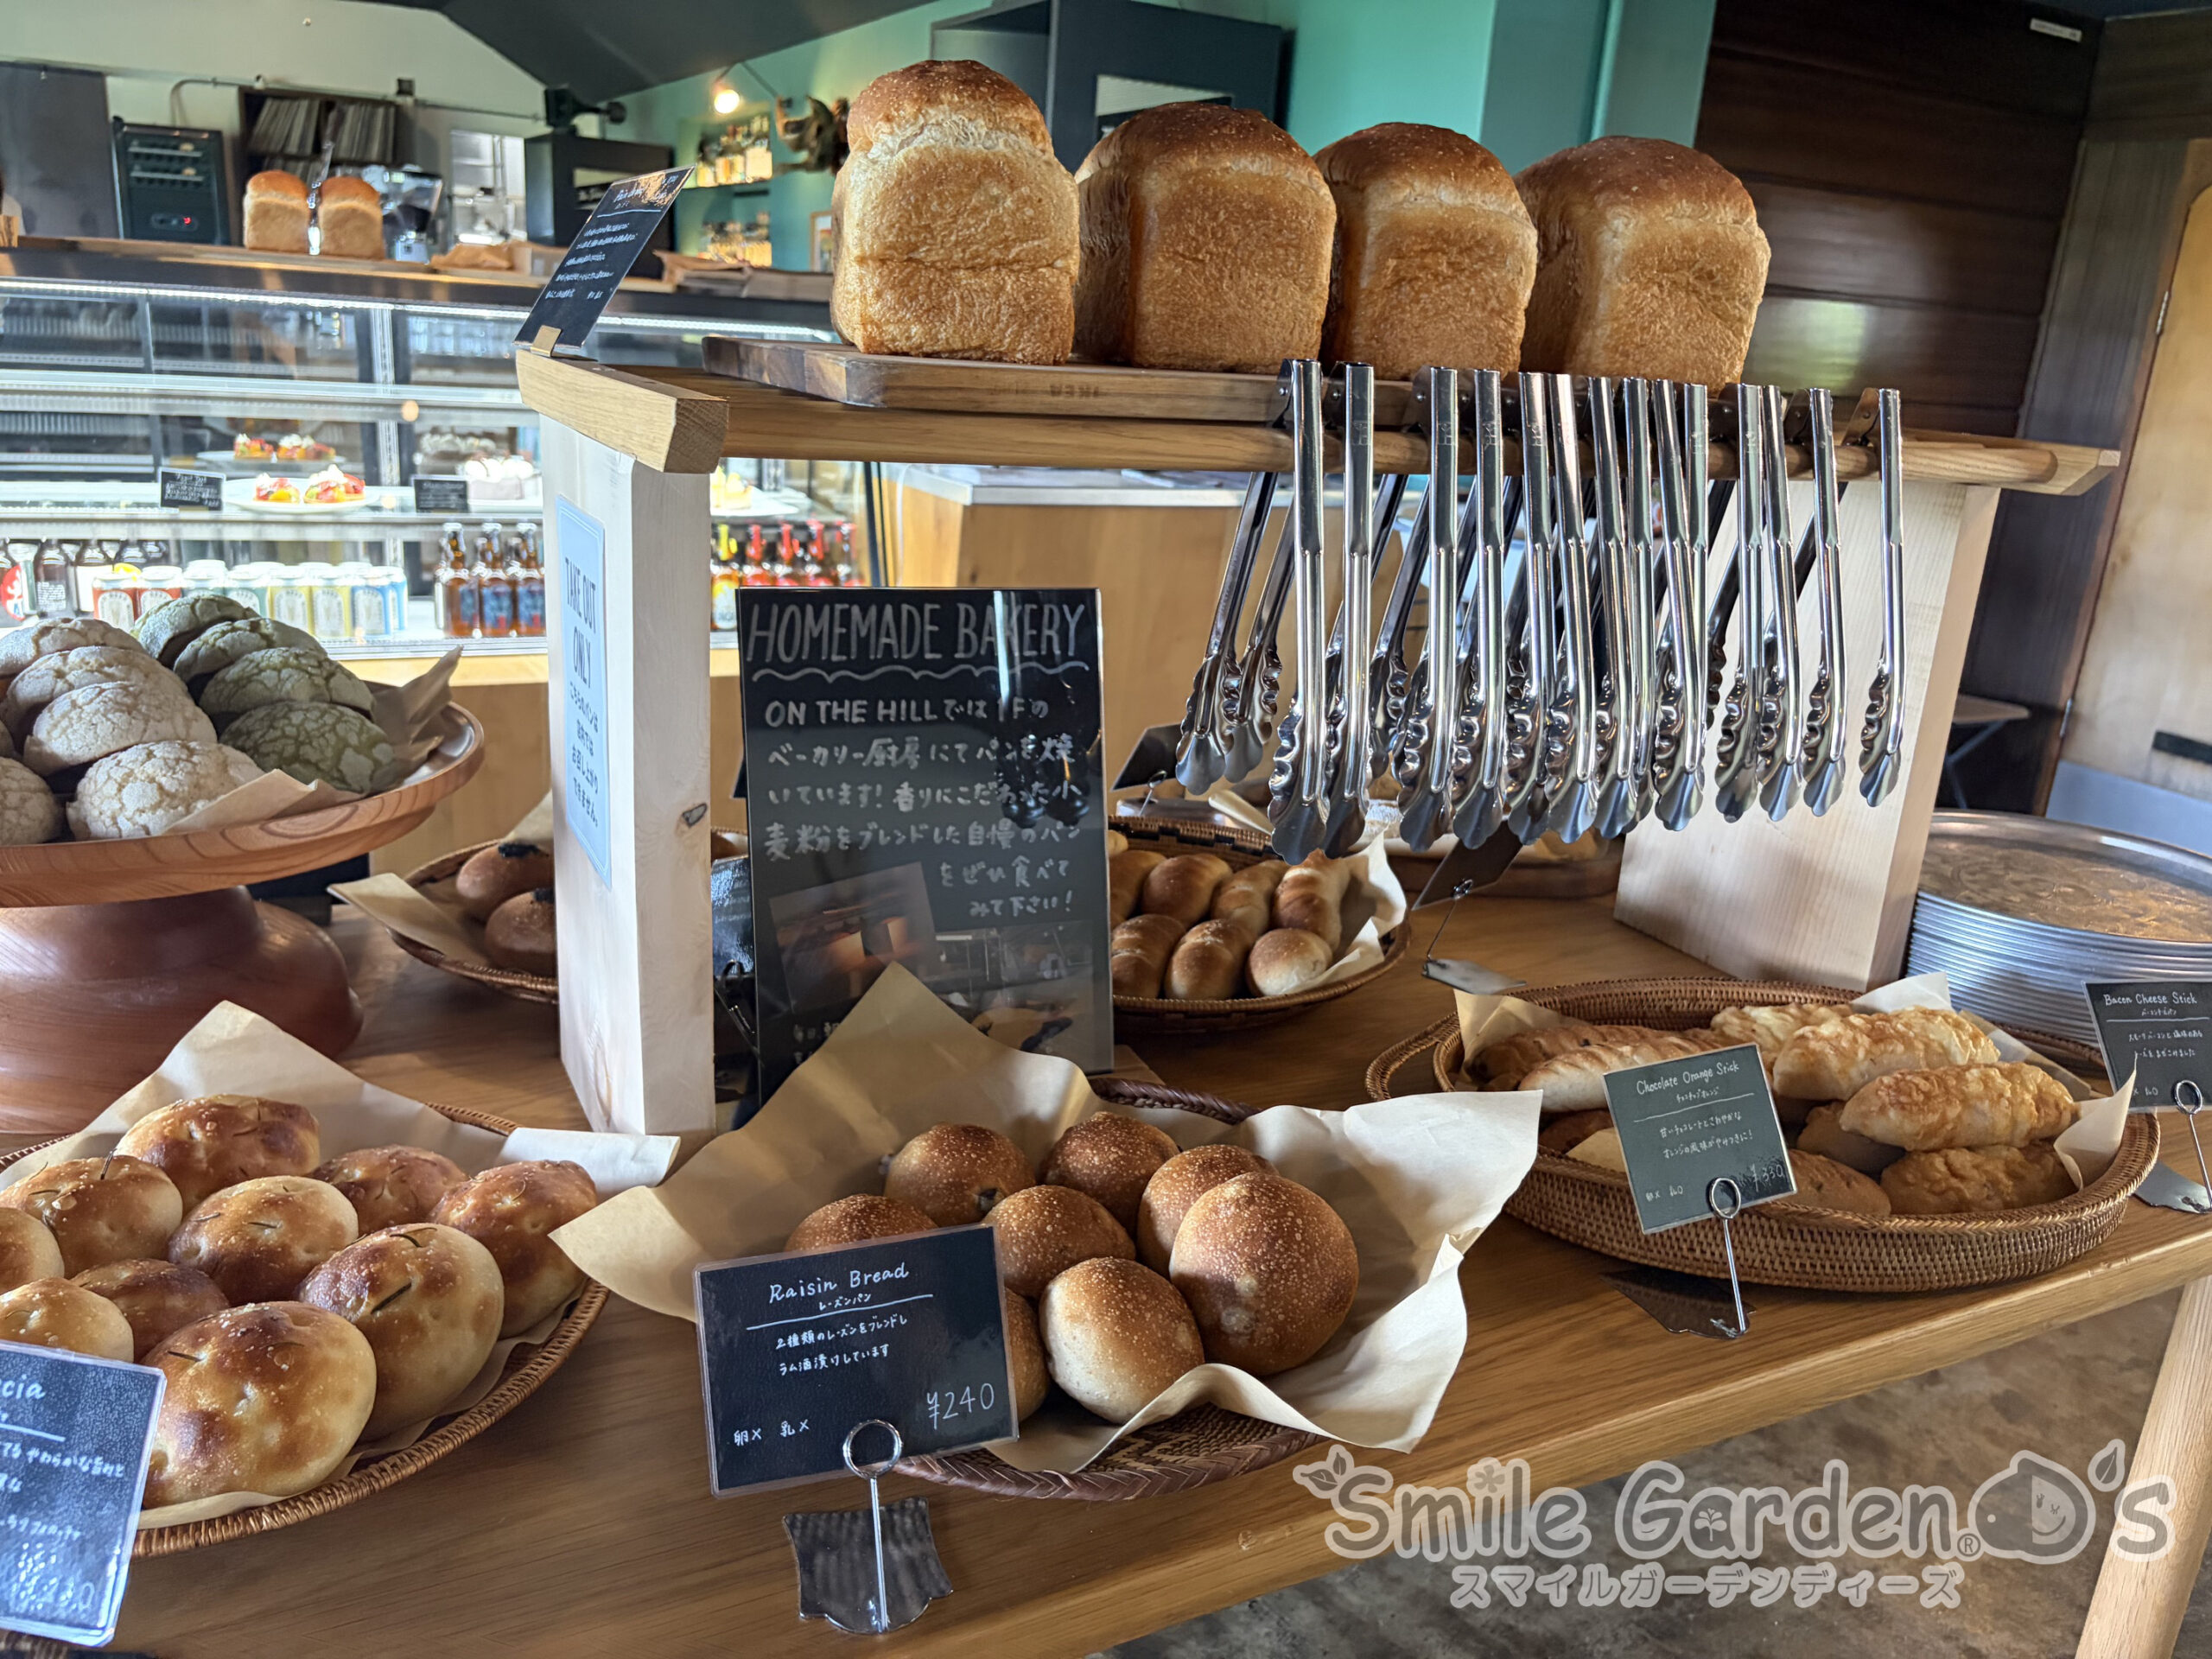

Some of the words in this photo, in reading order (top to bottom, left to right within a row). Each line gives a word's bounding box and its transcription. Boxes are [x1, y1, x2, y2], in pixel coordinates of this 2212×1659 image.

[565, 557, 582, 619] TAKE
[583, 575, 596, 634] OUT
[746, 603, 943, 663] HOMEMADE
[954, 602, 1085, 658] BAKERY
[573, 626, 591, 689] ONLY
[765, 700, 805, 728] ON
[815, 699, 867, 724] THE
[2103, 994, 2133, 1007] Bacon
[2135, 993, 2167, 1005] Cheese
[2171, 992, 2198, 1005] Stick
[1636, 1077, 1679, 1096] Chocolate
[1681, 1068, 1714, 1085] Orange
[1716, 1060, 1740, 1076] Stick
[768, 1278, 838, 1304] Raisin
[849, 1262, 910, 1288] Bread
[818, 1293, 872, 1312] レーズンパン
[0, 1373, 47, 1401] cia
[926, 1382, 995, 1430] ¥240
